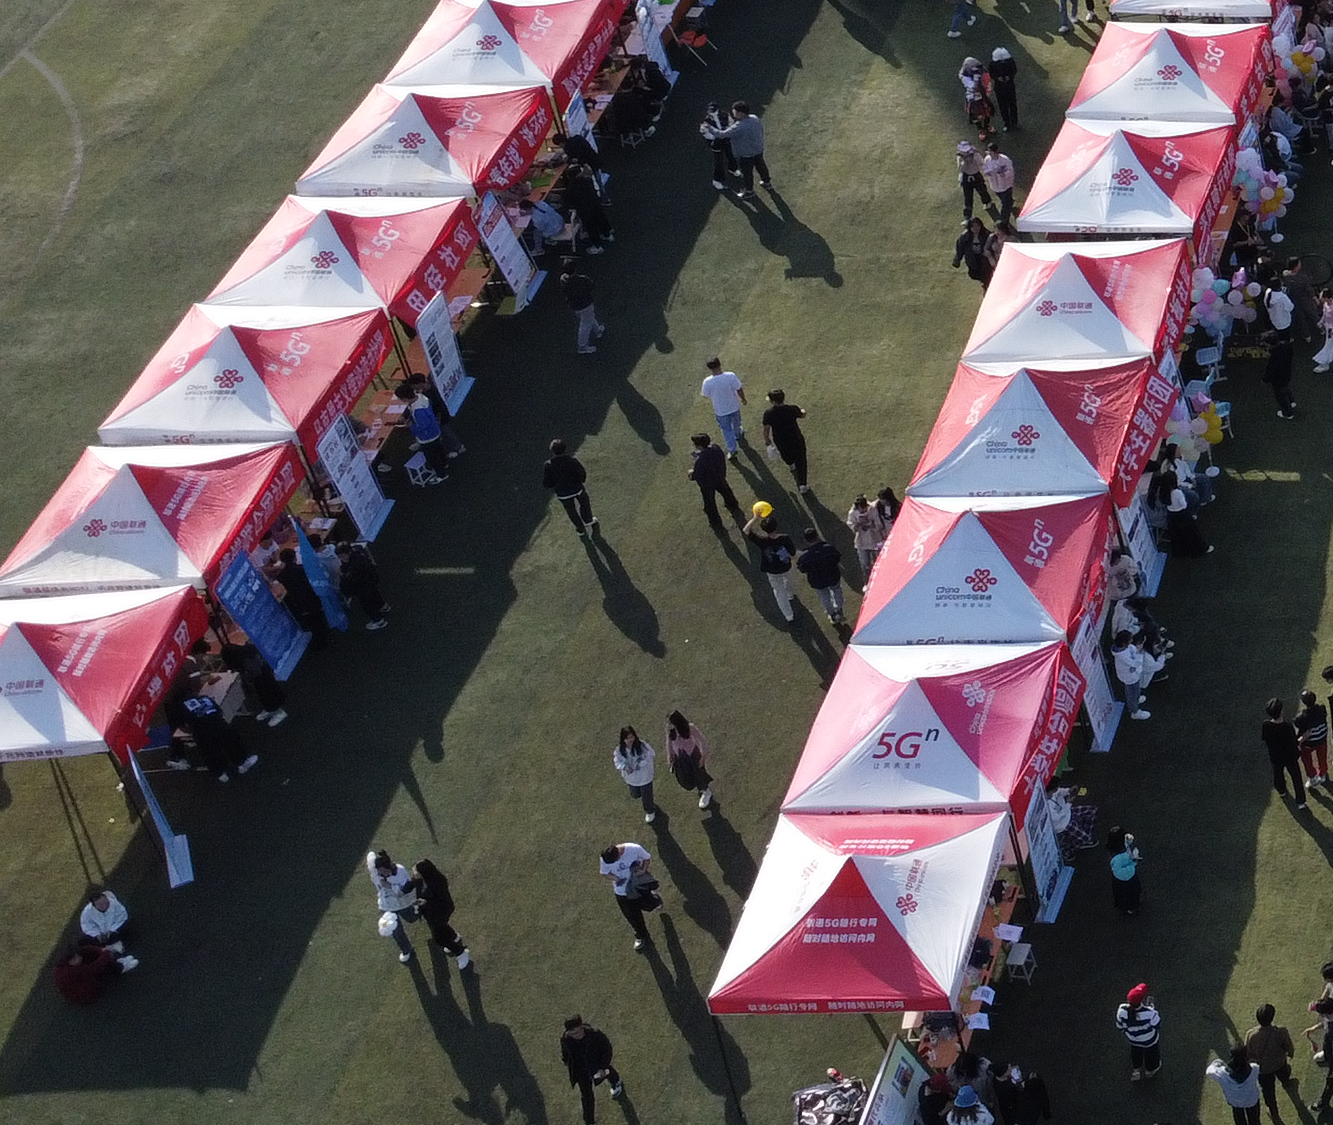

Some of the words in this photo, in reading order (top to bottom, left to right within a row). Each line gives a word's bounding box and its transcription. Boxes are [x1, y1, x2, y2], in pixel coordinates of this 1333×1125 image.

[1117, 376, 1175, 493] 大学生器乐团
[803, 934, 875, 943] 随时随地访问内网
